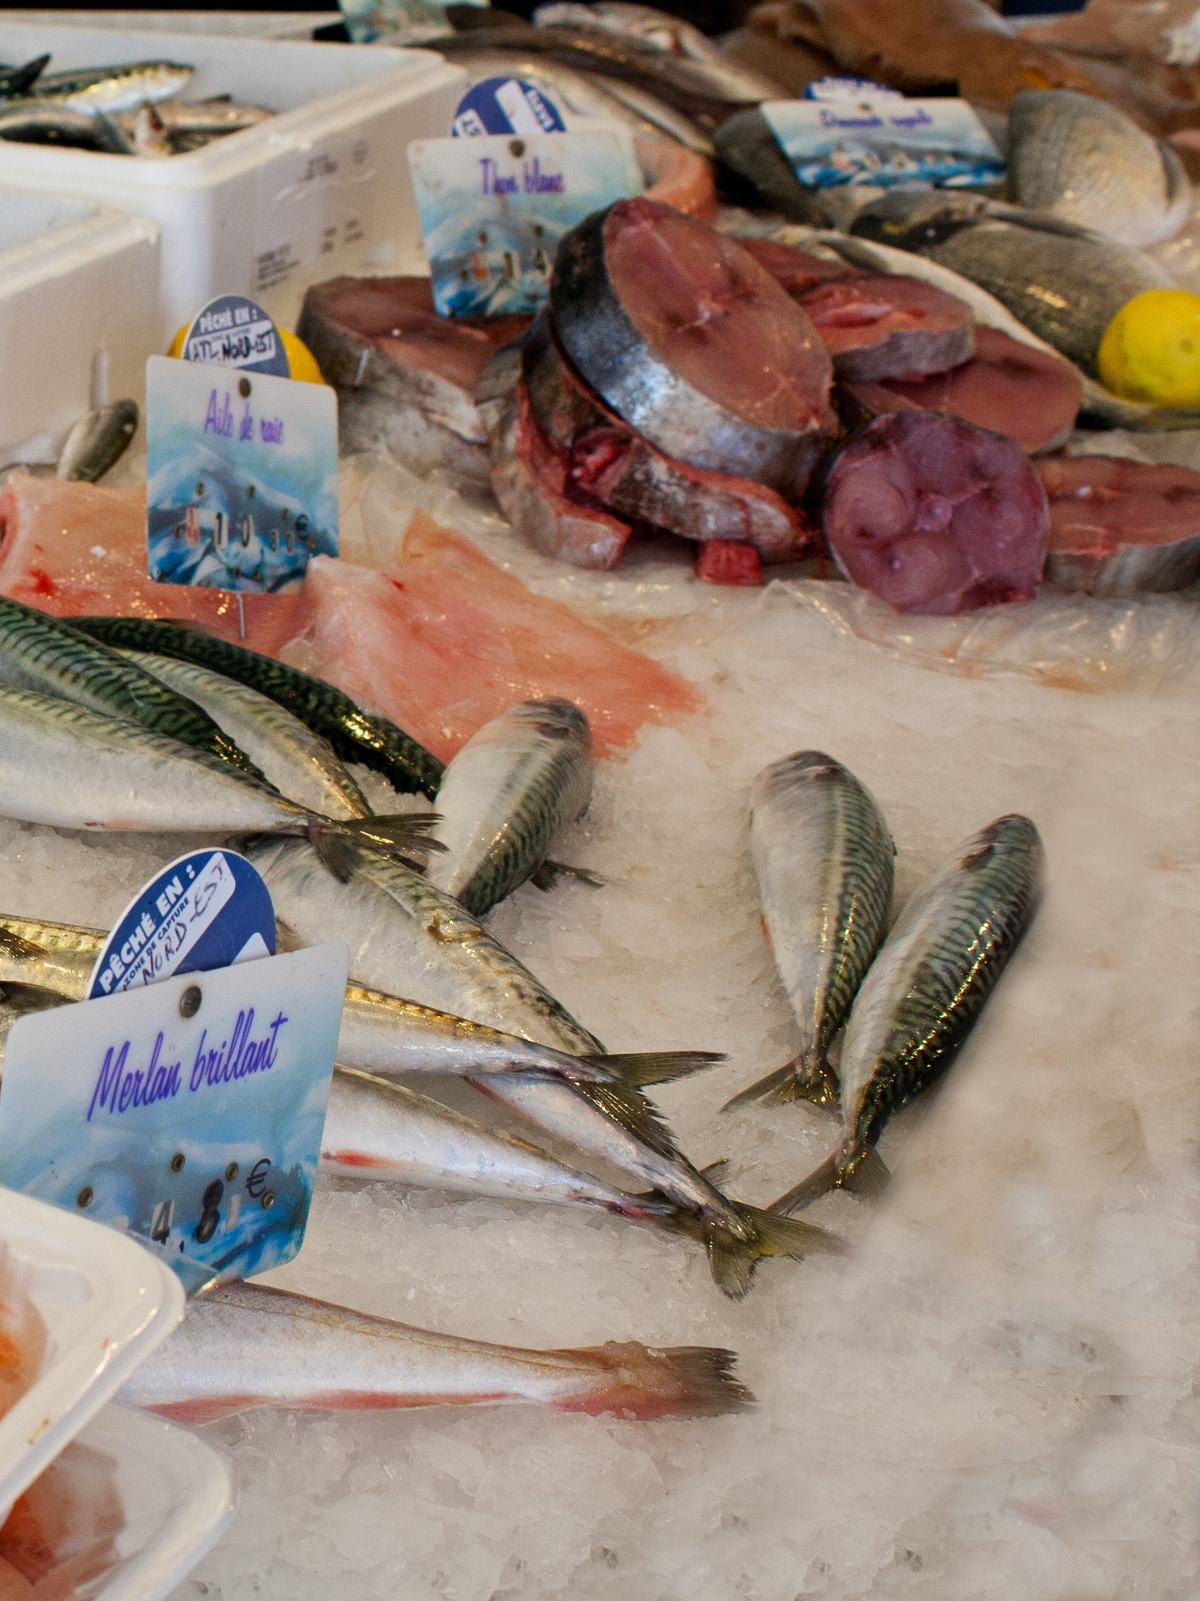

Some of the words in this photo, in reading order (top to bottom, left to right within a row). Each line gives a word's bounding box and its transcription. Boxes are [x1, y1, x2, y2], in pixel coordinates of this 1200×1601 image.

[99, 912, 156, 993] PÊCHÉ
[155, 876, 184, 917] EN
[124, 958, 146, 987] ZONE
[145, 942, 157, 957] DE
[157, 897, 190, 941] CAPTURE
[87, 1031, 182, 1122] Merlan
[189, 1007, 289, 1092] brillant
